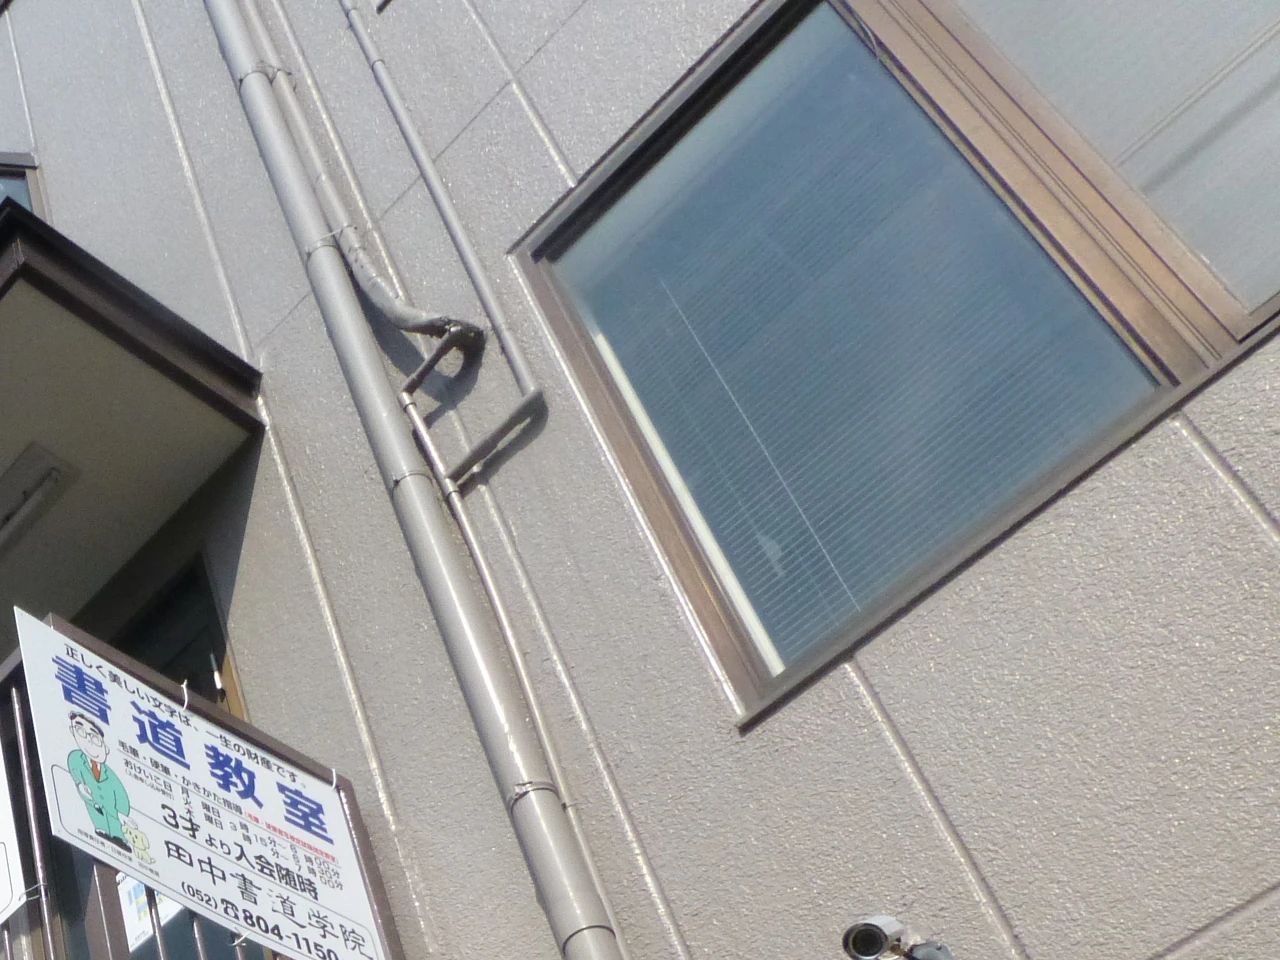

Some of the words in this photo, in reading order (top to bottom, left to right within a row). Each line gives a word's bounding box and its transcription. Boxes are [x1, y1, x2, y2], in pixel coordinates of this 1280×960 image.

[51, 655, 334, 845] 書道教室
[160, 803, 319, 902] 3才より入会随時
[163, 839, 374, 960] 田中書道学院
[181, 881, 218, 910] (052)
